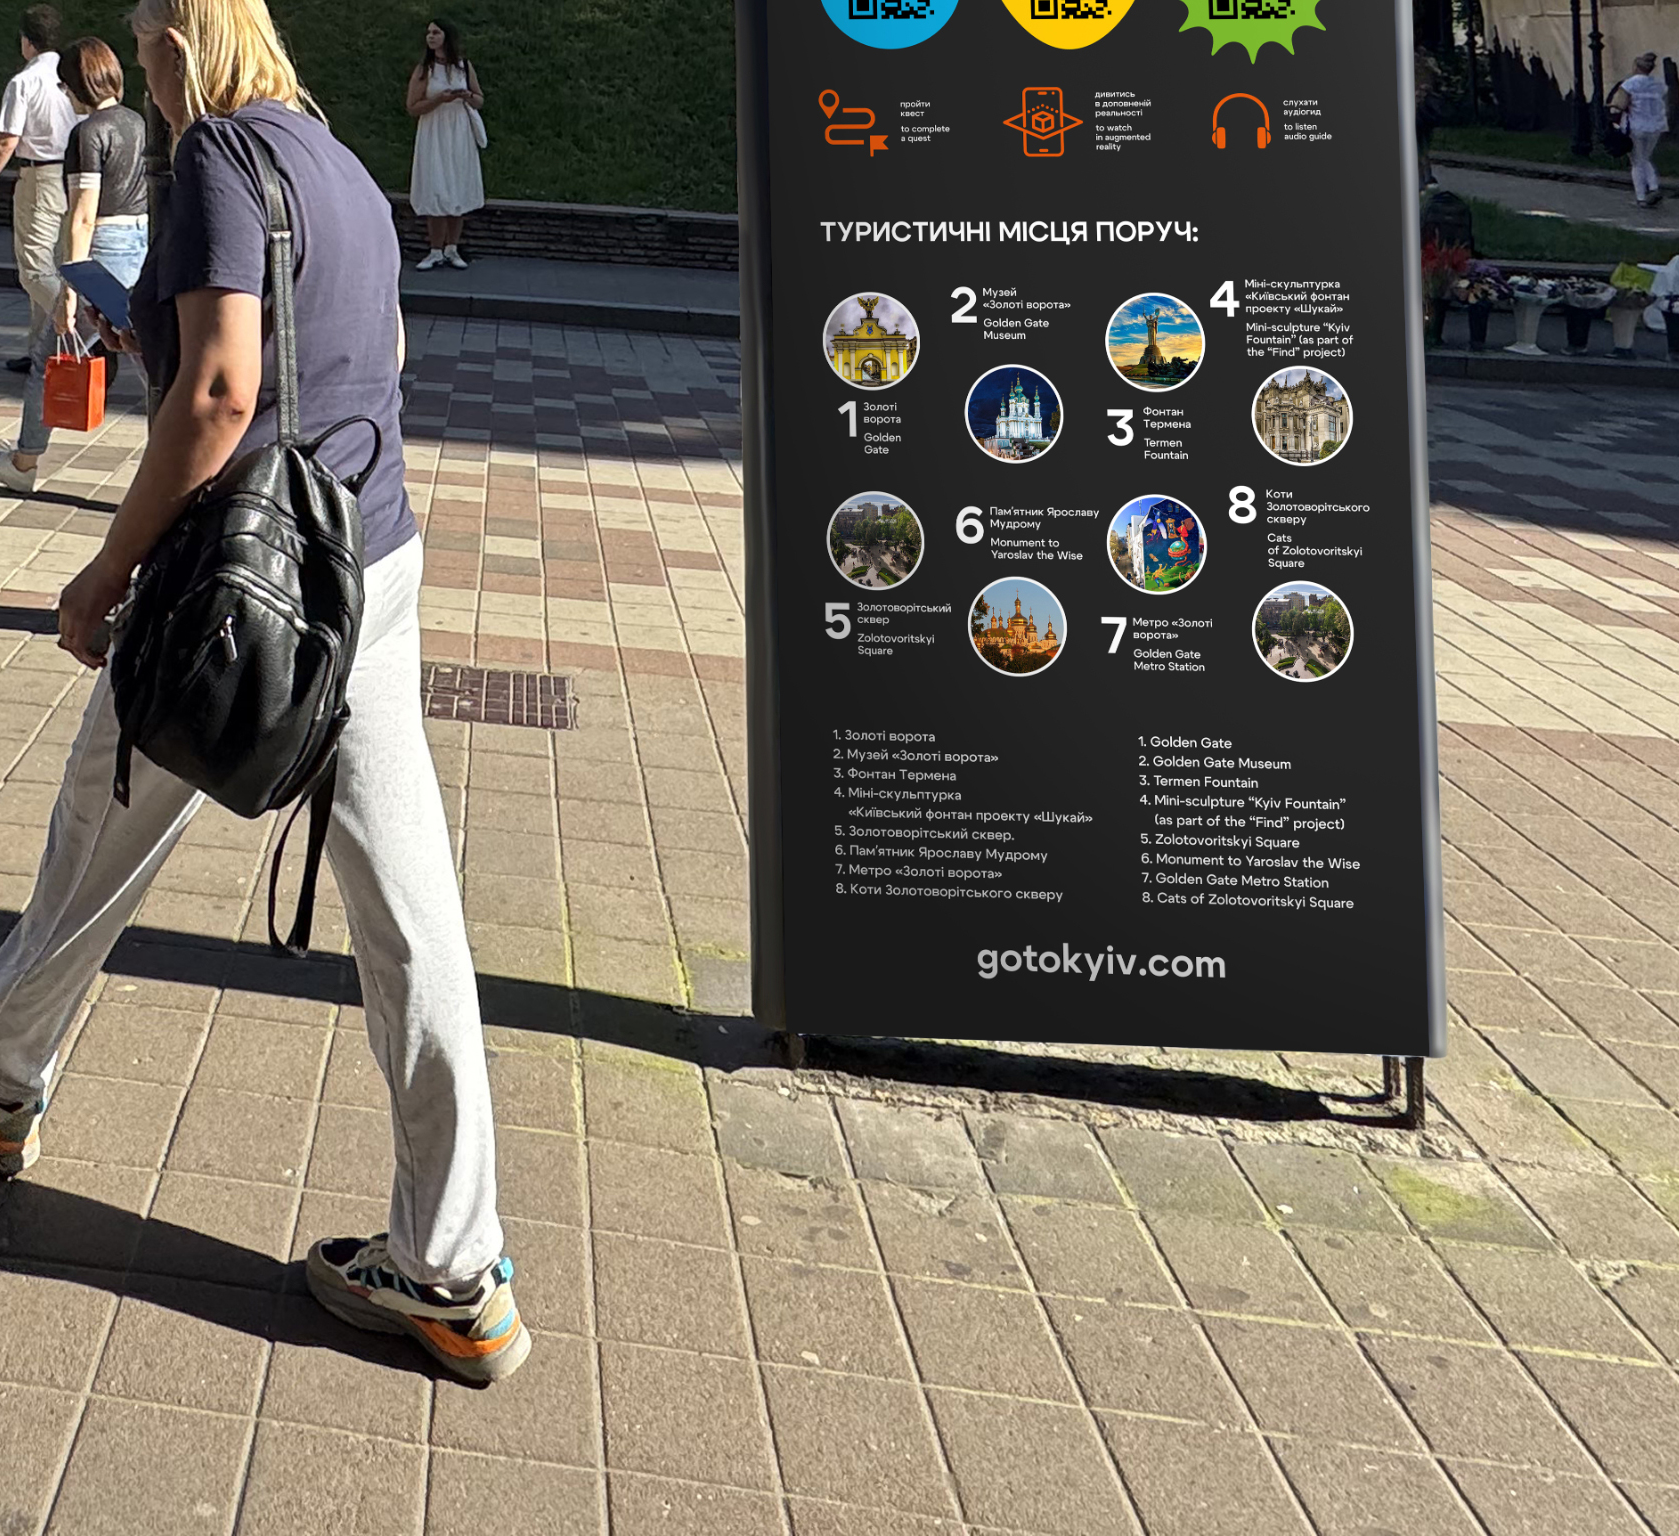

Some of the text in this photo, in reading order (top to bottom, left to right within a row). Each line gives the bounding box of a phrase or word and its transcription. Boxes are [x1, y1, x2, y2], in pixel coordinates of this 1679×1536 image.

[900, 99, 930, 108] пройти
[911, 124, 950, 133] complete
[907, 134, 931, 143] quest
[820, 220, 1198, 245] ТУРИСТИЧНІ МІСЦЯ ПОРУЧ:
[1244, 278, 1340, 290] Міні-скульптурка
[982, 287, 1016, 298] Музей
[1209, 280, 1240, 317] 4
[1245, 291, 1349, 302] «Київський фонтан
[950, 286, 977, 323] 2
[982, 299, 1071, 311] «Золоті ворота»
[1245, 303, 1343, 315] проекту «Шукай»
[983, 317, 1049, 327] Golden Gate
[1246, 322, 1320, 334] Mini-sculpture
[983, 330, 1026, 339] Museum
[1298, 334, 1314, 344] (as
[1316, 335, 1339, 346] part
[1341, 334, 1353, 344] of
[1246, 346, 1264, 356] the
[1303, 347, 1345, 359] project)
[863, 401, 897, 411] Золоті
[1142, 406, 1183, 416] Фонтан
[837, 400, 857, 437] 1
[863, 416, 901, 425] ворота
[1142, 419, 1191, 430] Термена
[1106, 408, 1134, 446] 3
[863, 432, 901, 442] Golden
[1143, 437, 1182, 447] Termen
[864, 444, 889, 454] Gate
[1144, 450, 1188, 459] Fountain
[1265, 489, 1292, 498] Коти
[1228, 485, 1257, 524] 8
[1266, 501, 1370, 513] Золотоворітського
[1046, 506, 1099, 519] Ярославу
[955, 505, 984, 544] 6
[989, 518, 1041, 530] Мудрому
[1266, 516, 1306, 526] скверу
[990, 537, 1059, 547] Monument to
[1267, 532, 1292, 542] Cats
[990, 549, 1083, 560] Yaroslav the Wise
[1267, 544, 1362, 558] of Zolotovoritskyi
[1267, 557, 1305, 569] Square
[857, 601, 951, 614] Золотоворітський
[824, 602, 851, 639] 5
[856, 616, 889, 626] сквер
[1132, 617, 1212, 628] Метро «Золоті
[857, 633, 934, 645] Zolotovoritskyi
[1100, 616, 1127, 653] 7
[1133, 631, 1178, 641] ворота»
[857, 645, 893, 656] Square
[1133, 648, 1201, 659] Golden Gate
[1133, 660, 1205, 671] Metro Station
[832, 729, 935, 744] 1. Золоті ворота
[1137, 735, 1232, 749] 1. Golden Gate
[833, 748, 998, 764] 2. Музей «Золоті ворота»
[1138, 755, 1291, 769] 2. Golden Gate Museum
[833, 766, 956, 782] 3. Фонтан Термена
[1139, 774, 1258, 788] 3. Termen Fountain
[833, 786, 961, 802] 4. Міні-скульптурка
[1139, 794, 1151, 805] 4.
[1154, 794, 1244, 809] Mini-sculpture
[848, 806, 1093, 825] «Київський фонтан проекту «Шукай»
[1154, 813, 1172, 825] (as
[1176, 815, 1202, 828] part
[1206, 814, 1220, 826] of
[1224, 815, 1245, 827] the
[1293, 817, 1344, 831] project)
[834, 824, 1014, 842] 5. Золотоворітський сквер.
[1140, 833, 1299, 850] 5. Zolotovoritskyi Square
[834, 844, 846, 855] 6.
[918, 846, 981, 861] Ярославу
[985, 848, 1047, 863] Мудрому
[1141, 852, 1360, 869] 6. Monument to Yaroslav the Wise
[835, 863, 1002, 880] 7. Метро «Золоті ворота»
[1141, 872, 1329, 888] 7. Golden Gate Metro Station
[835, 882, 1063, 903] 8. Коти Золотоворітського скверу
[1142, 891, 1354, 910] 8. Cats of Zolotovoritskyi Square
[977, 942, 1225, 981] gotokyiv.com
